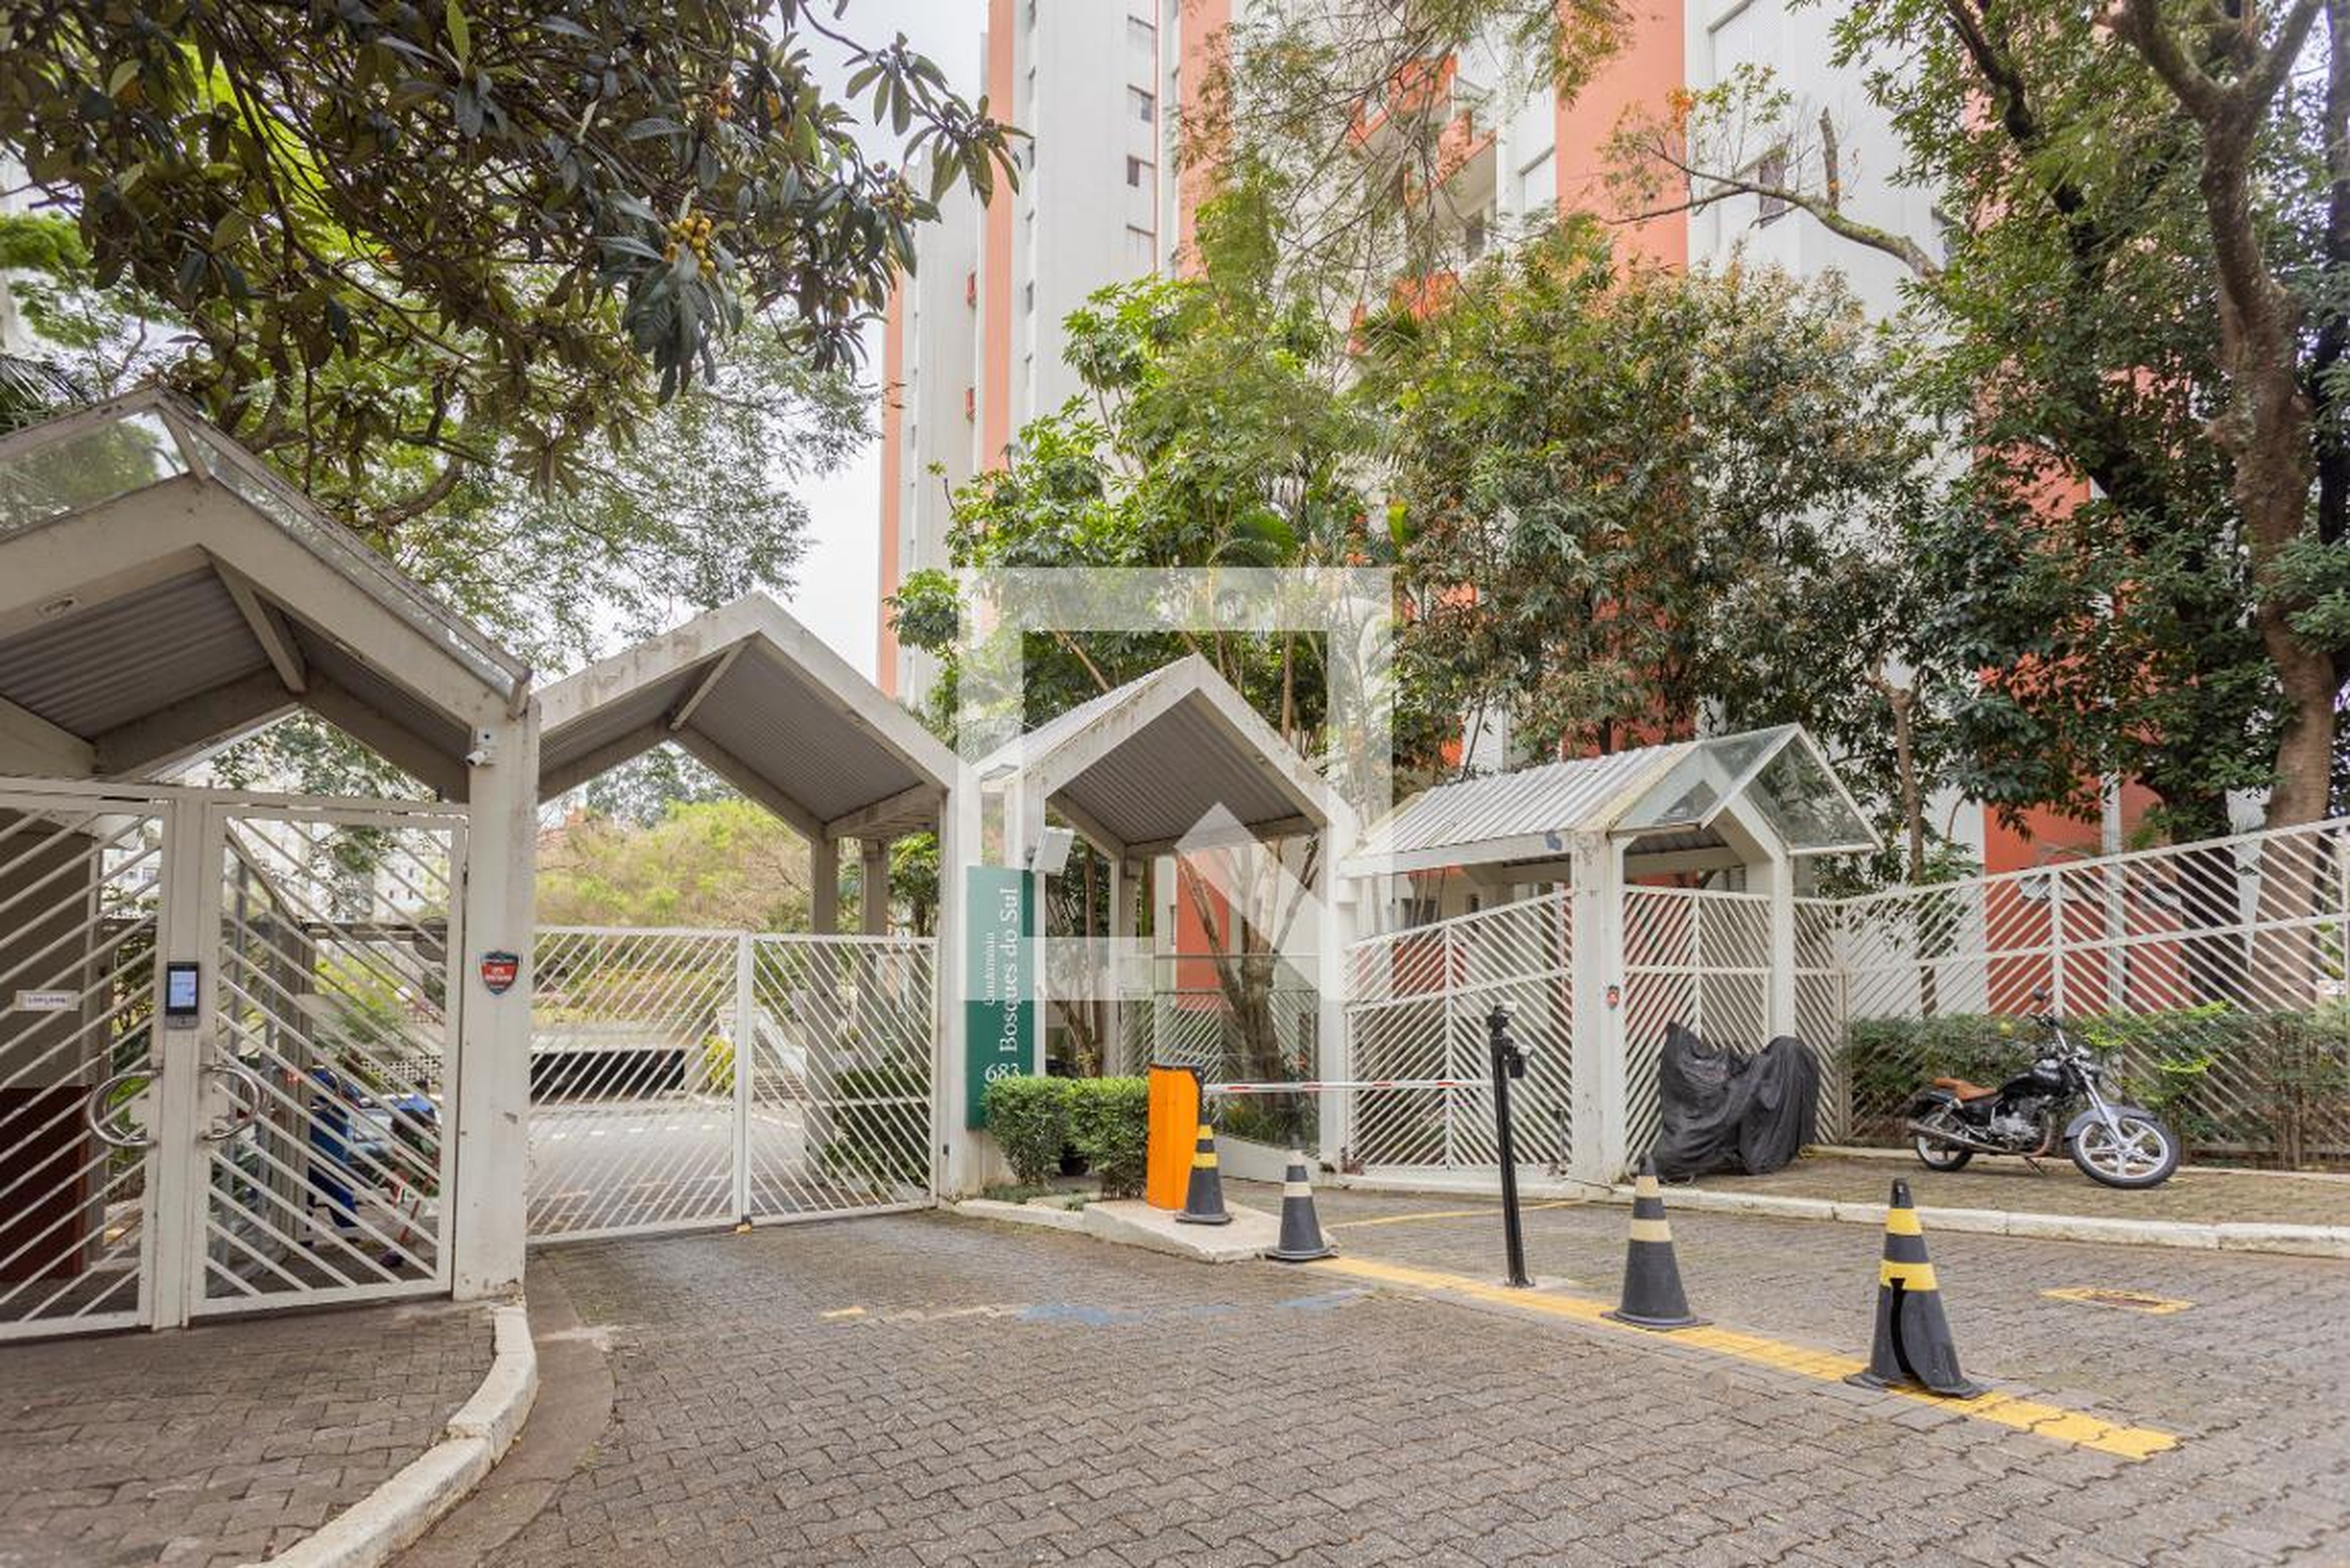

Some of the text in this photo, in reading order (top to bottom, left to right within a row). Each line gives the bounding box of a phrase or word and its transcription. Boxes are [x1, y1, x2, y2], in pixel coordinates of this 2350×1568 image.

[999, 888, 1020, 1051] Bosques do Sul
